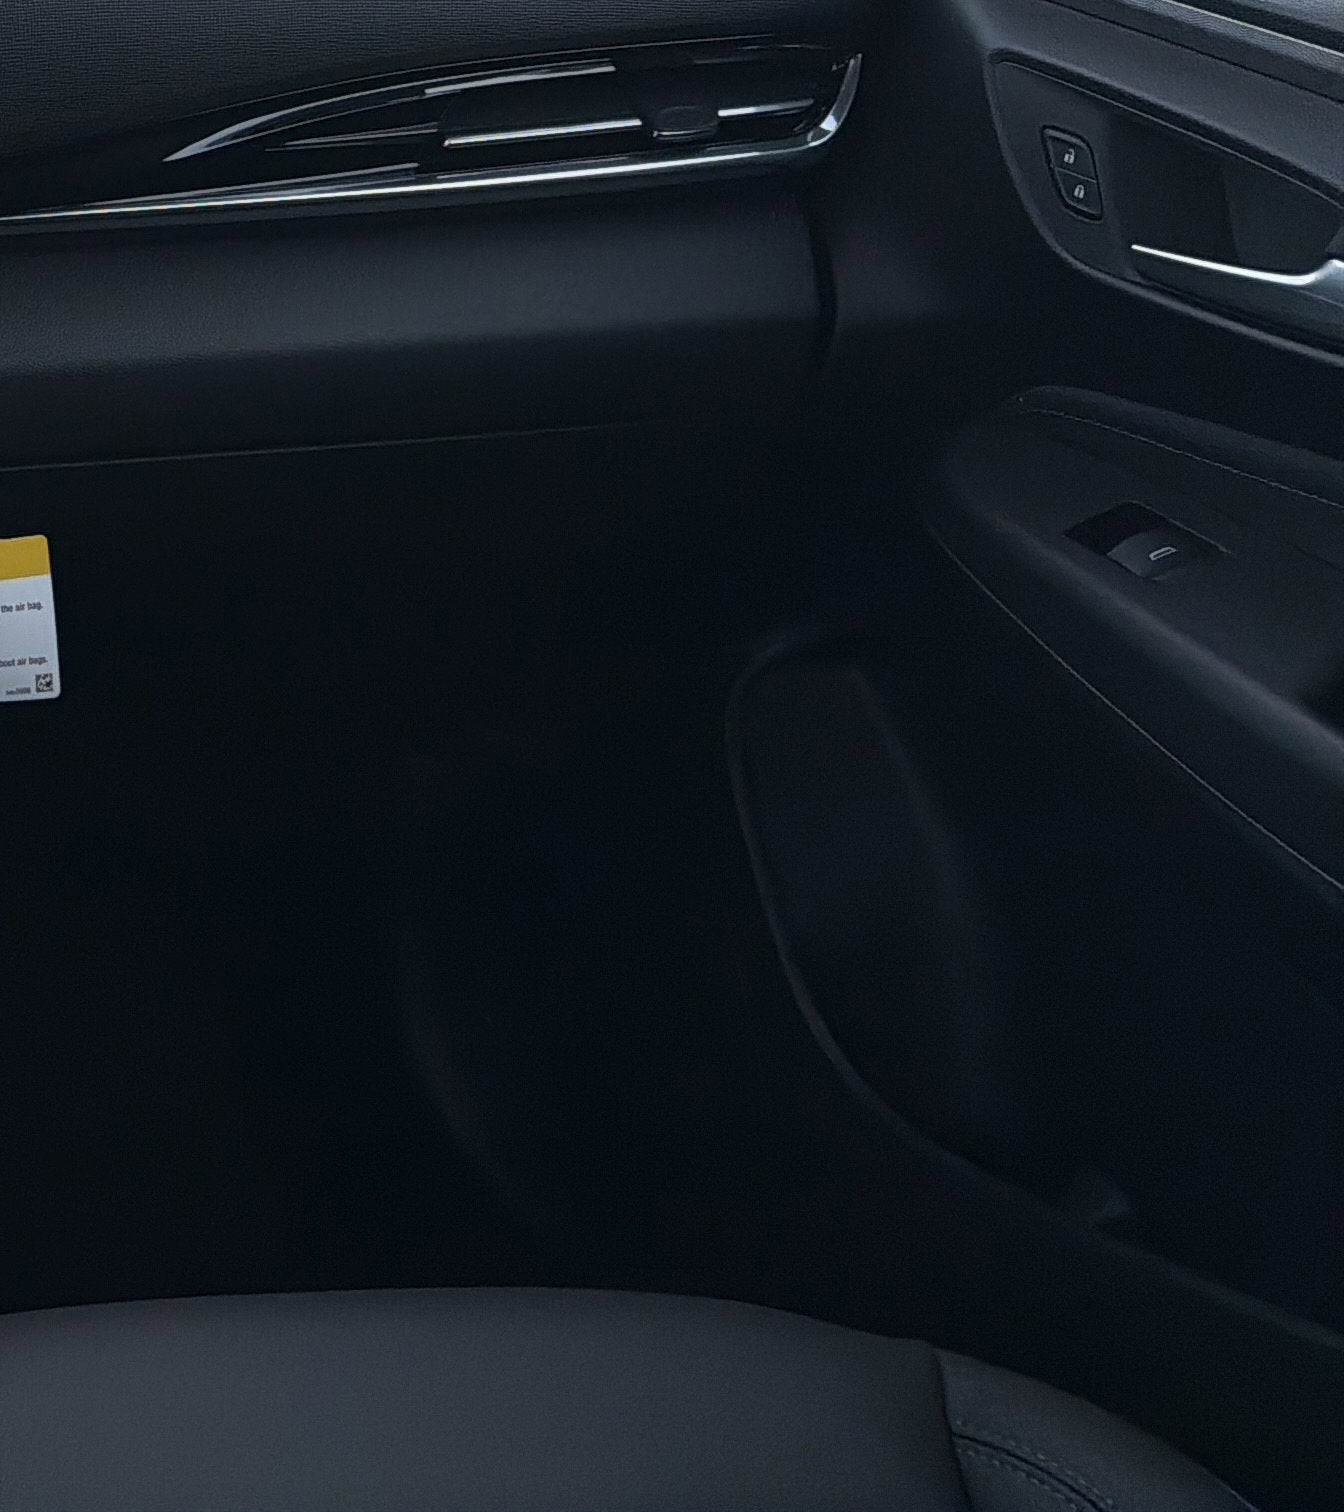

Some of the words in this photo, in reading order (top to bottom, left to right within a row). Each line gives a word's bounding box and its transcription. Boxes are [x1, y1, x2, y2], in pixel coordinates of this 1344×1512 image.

[0, 604, 13, 612] the
[15, 602, 25, 610] air
[27, 600, 42, 610] bag.
[17, 657, 27, 665] air
[28, 655, 47, 666] bags.
